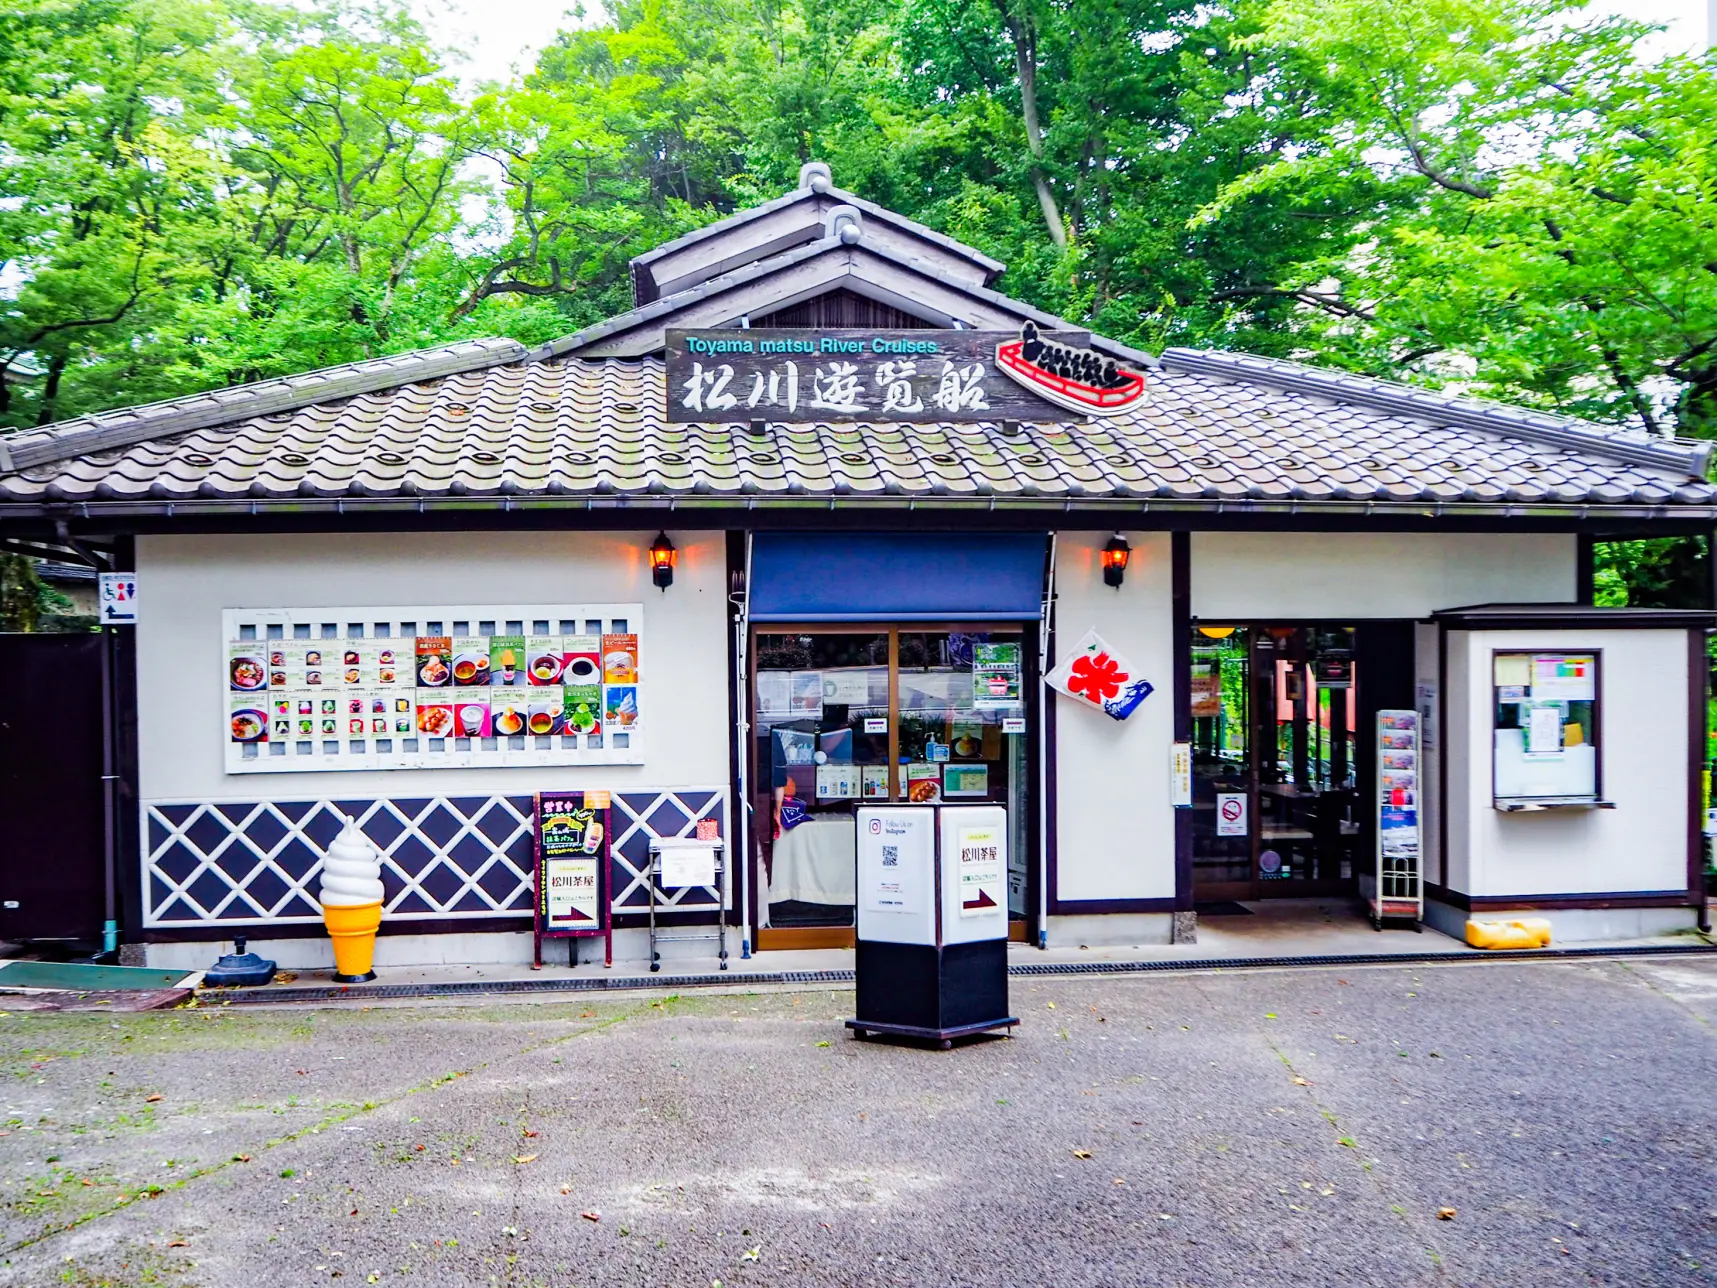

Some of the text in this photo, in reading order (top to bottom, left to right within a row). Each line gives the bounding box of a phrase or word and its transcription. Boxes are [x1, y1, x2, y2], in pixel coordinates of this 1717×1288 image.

[685, 336, 939, 356] Toyama matsu River Cruises
[682, 360, 991, 413] 松川遊覧船
[962, 846, 997, 862] 松川茶屋
[552, 876, 594, 887] 松川茶屋
